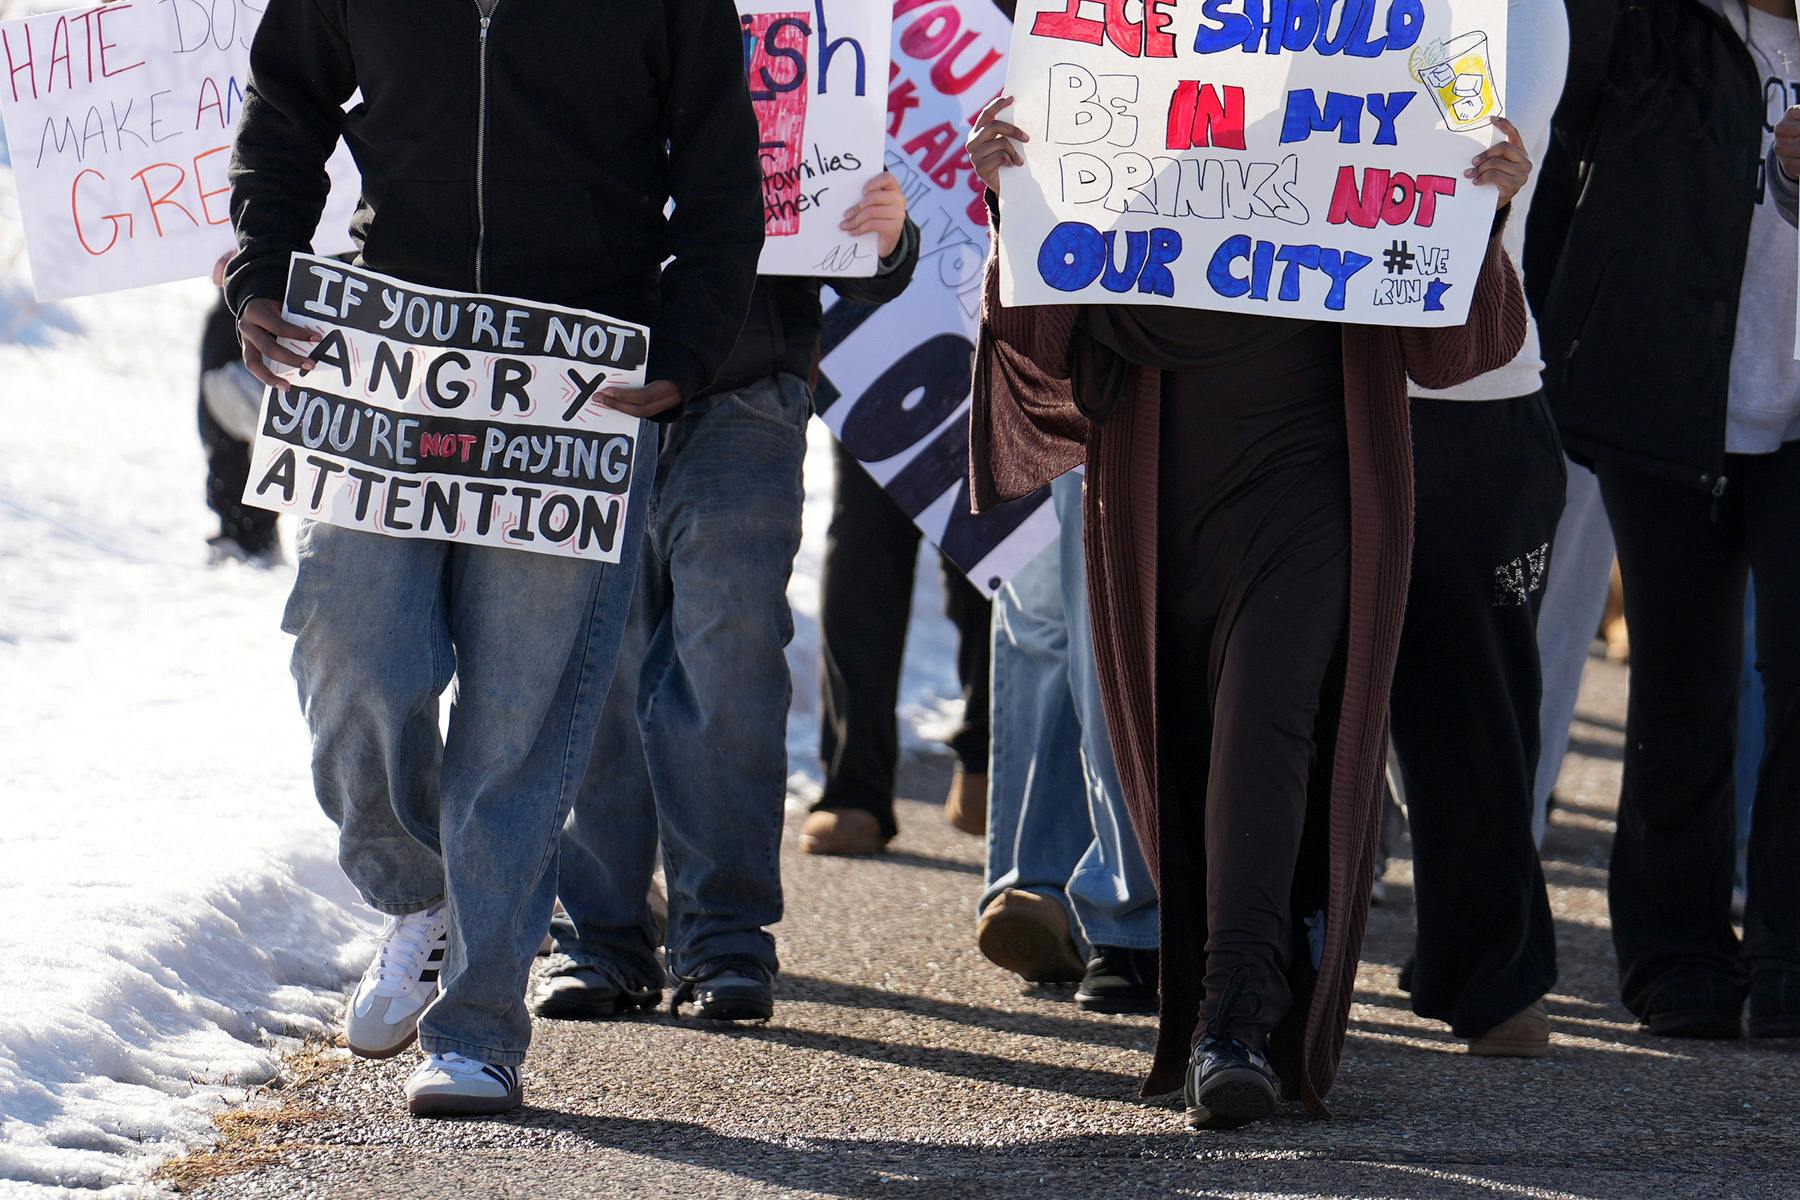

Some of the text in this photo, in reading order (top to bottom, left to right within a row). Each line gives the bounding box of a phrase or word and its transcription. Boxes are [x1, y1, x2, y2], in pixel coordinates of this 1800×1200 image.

[2, 5, 145, 103] HATE
[37, 90, 183, 169] MAKE
[1045, 62, 1418, 151] BE IN MY
[72, 144, 231, 256] GRE
[1059, 151, 1457, 229] DRINKS NOT
[1037, 221, 1373, 311] OUR CITY
[1373, 278, 1421, 305] RUN
[304, 265, 637, 362] IF YOU'RE NOT
[299, 329, 607, 422] ANGRY
[272, 388, 630, 483] YOU'RE NOT PAYING
[256, 448, 620, 554] ATTENTION
